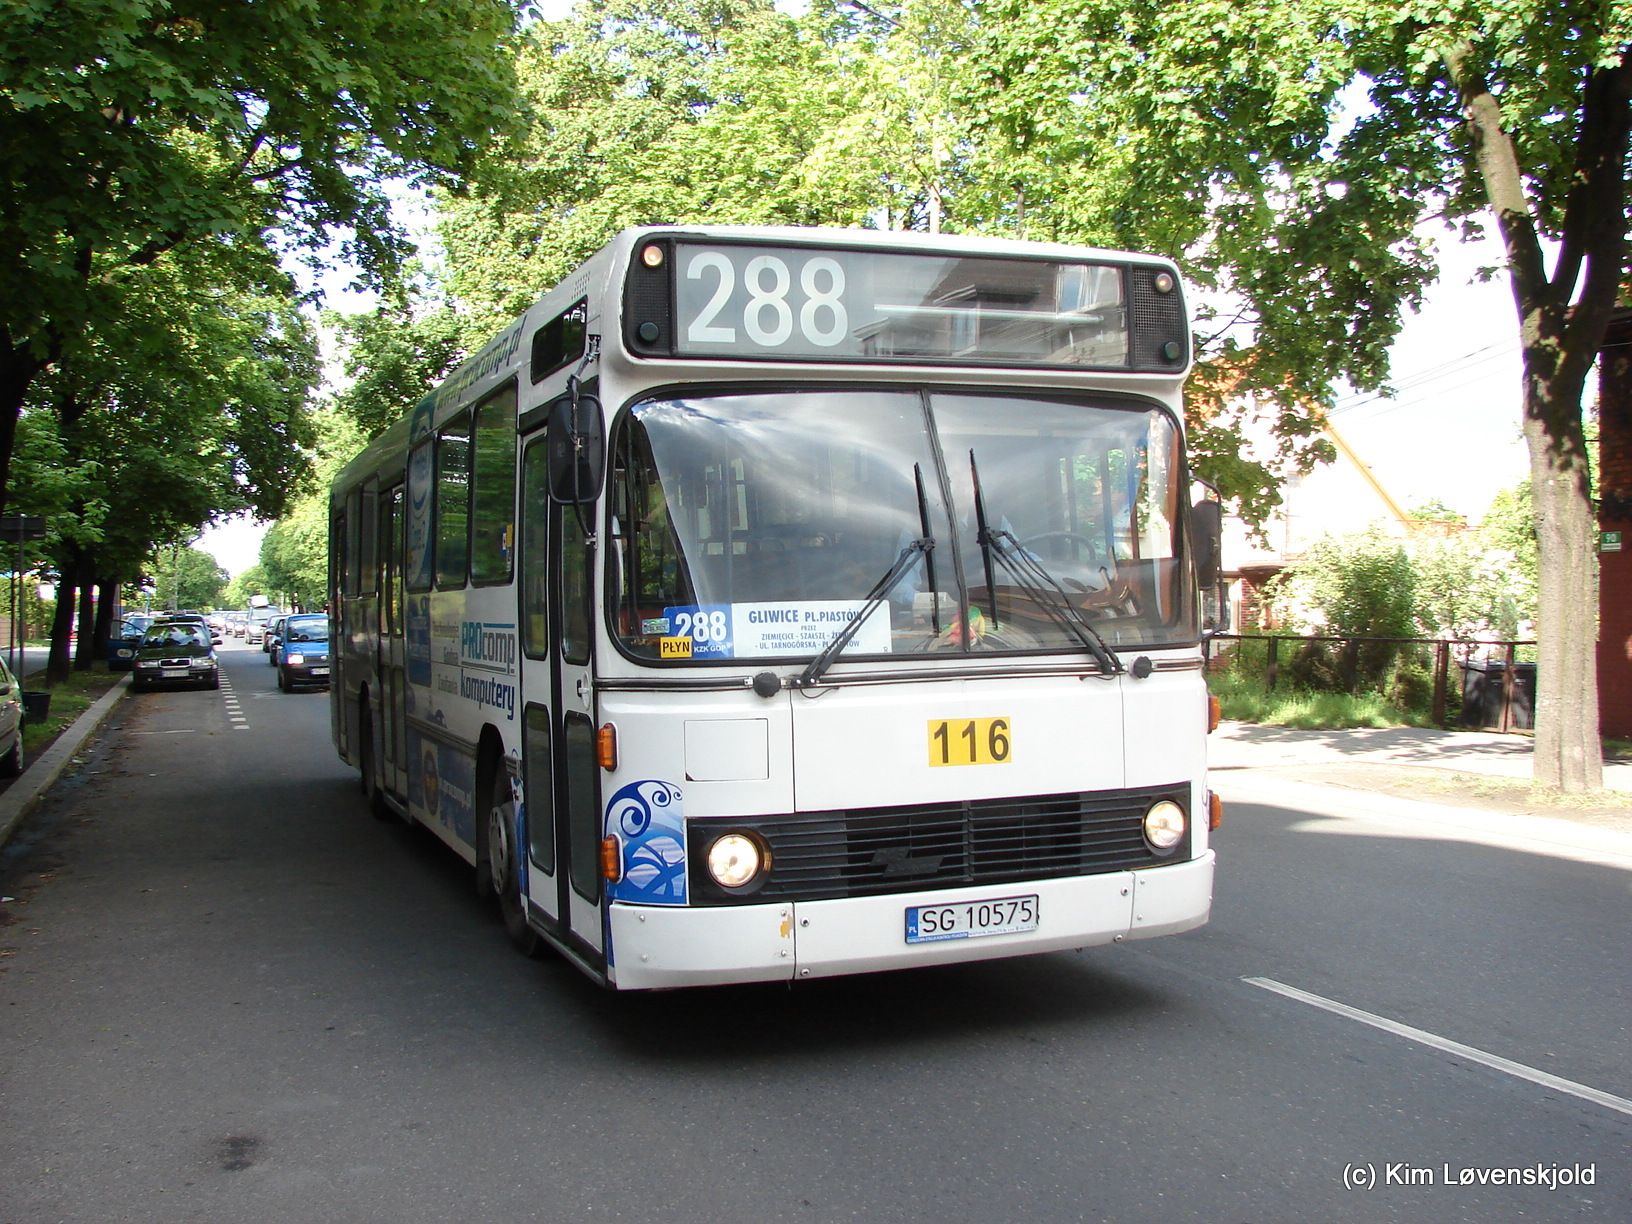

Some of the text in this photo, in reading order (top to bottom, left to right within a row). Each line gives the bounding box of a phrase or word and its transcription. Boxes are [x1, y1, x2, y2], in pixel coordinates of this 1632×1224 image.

[686, 251, 849, 347] 288
[675, 610, 727, 643] 288
[748, 609, 799, 624] GLIWICE
[662, 641, 690, 653] PŁYN
[710, 644, 726, 652] GOP
[759, 642, 770, 650] UL.
[460, 667, 515, 721] komputery
[933, 718, 1010, 764] 116
[922, 908, 956, 933] SG
[966, 900, 1033, 929] 10575
[908, 925, 918, 934] PL
